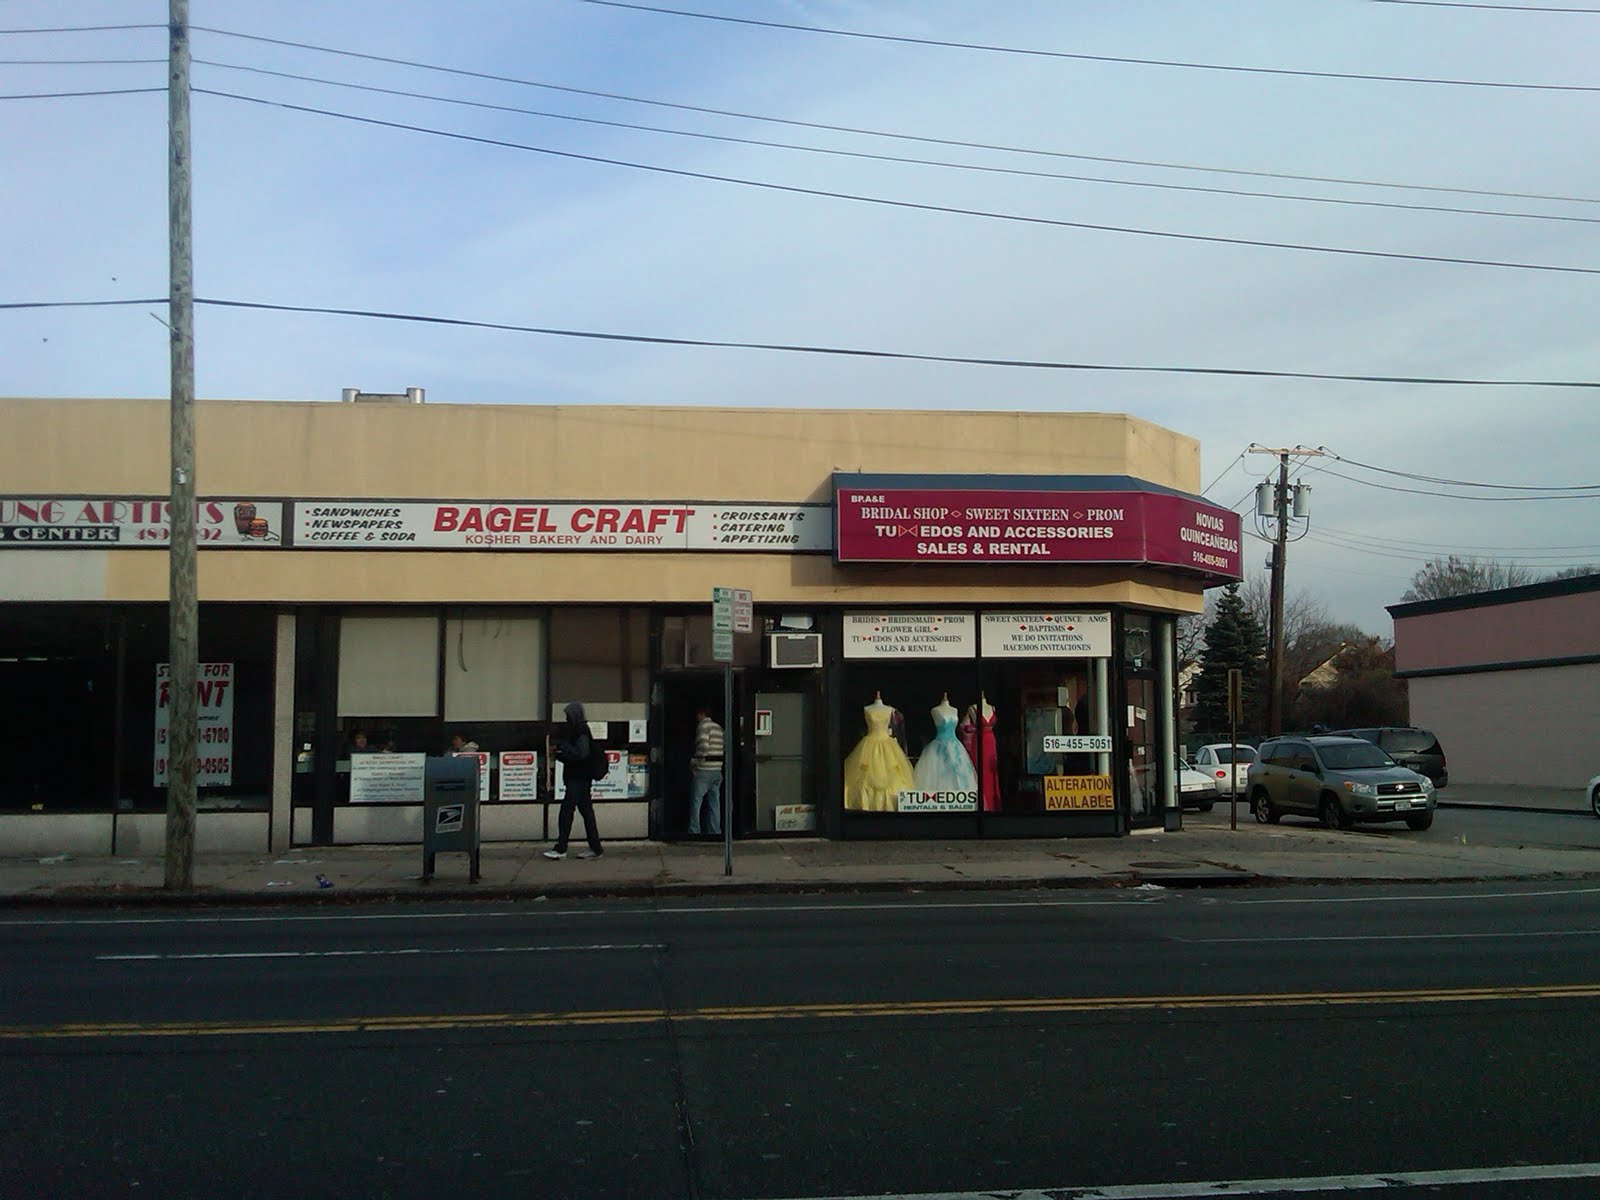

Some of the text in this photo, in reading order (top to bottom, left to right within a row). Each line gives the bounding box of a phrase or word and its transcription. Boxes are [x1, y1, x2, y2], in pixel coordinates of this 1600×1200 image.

[75, 501, 224, 524] ARTIS
[311, 507, 401, 517] SANDWICHES
[720, 511, 805, 521] CROISSANTS
[861, 507, 1124, 521] BRIDAL SHOP SWEET SIXTEEN PROM
[311, 519, 403, 530] NEWSPAPERS
[433, 506, 695, 534] BAGEL CRAFT
[1196, 512, 1224, 532] NOVIAS
[13, 527, 117, 540] CENTER
[720, 523, 786, 533] CATERING
[967, 526, 1001, 538] AND
[1004, 526, 1114, 539] ACCESSORIES
[311, 531, 416, 542] COFFEE & SODA
[465, 535, 663, 545] KOSHER BAKERY AND DAIRY
[720, 534, 800, 544] APPETIZING
[916, 542, 1050, 555] SALES & RENTAL
[852, 616, 965, 624] BRIDES BRIDESMAID PROM
[985, 615, 1011, 623] SWEET
[1012, 615, 1045, 623] SIXTEEN
[1054, 615, 1083, 624] QUINCE
[894, 635, 910, 643] AND
[912, 635, 962, 643] ACCESSORIES
[1011, 634, 1084, 642] WE DO INVITATIONS
[204, 664, 230, 677] FOR
[158, 680, 230, 708] RNT
[1044, 738, 1112, 750] 516-455-5051
[1046, 778, 1111, 791] ALTERATION
[1047, 796, 1113, 809] AVAILABLE
